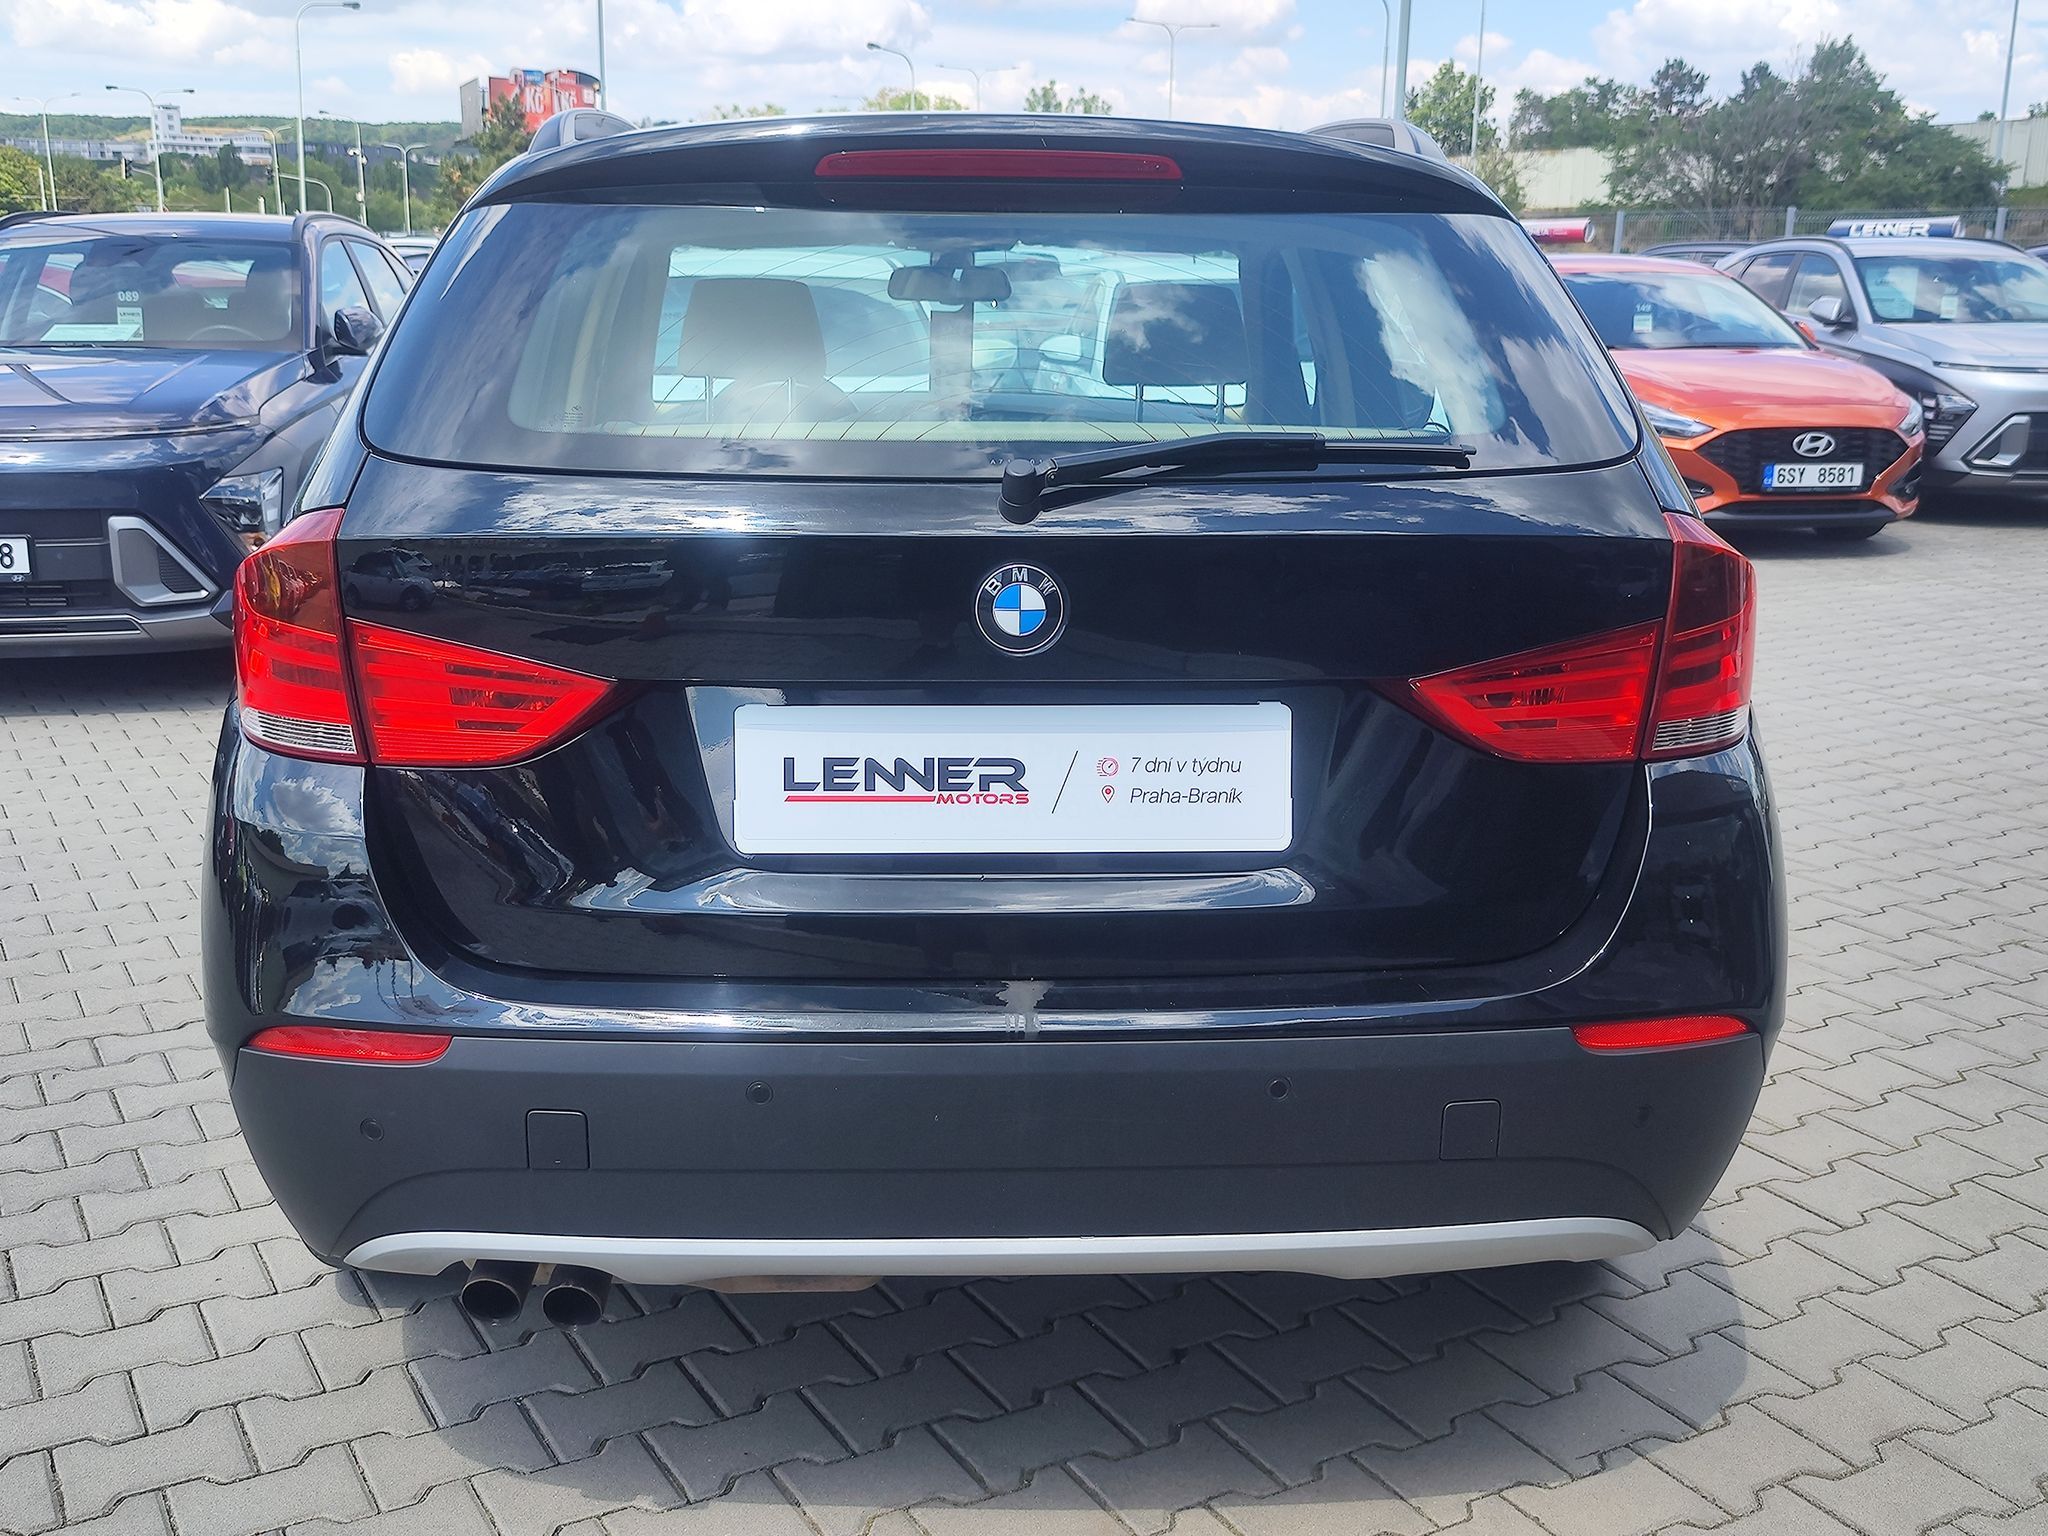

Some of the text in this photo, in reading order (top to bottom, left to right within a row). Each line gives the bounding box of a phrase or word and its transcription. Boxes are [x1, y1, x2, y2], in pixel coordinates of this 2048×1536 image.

[1848, 222, 1930, 238] LENNER
[118, 290, 139, 301] 089
[1777, 467, 1806, 484] 6SY
[1817, 467, 1855, 484] 8581
[0, 543, 14, 569] 8
[985, 567, 1057, 596] BMW
[783, 757, 1029, 792] LENNER
[1131, 756, 1242, 777] 7 dní v týdnu
[936, 793, 1029, 805] MOTORS
[1130, 787, 1243, 804] Praha-Braník
